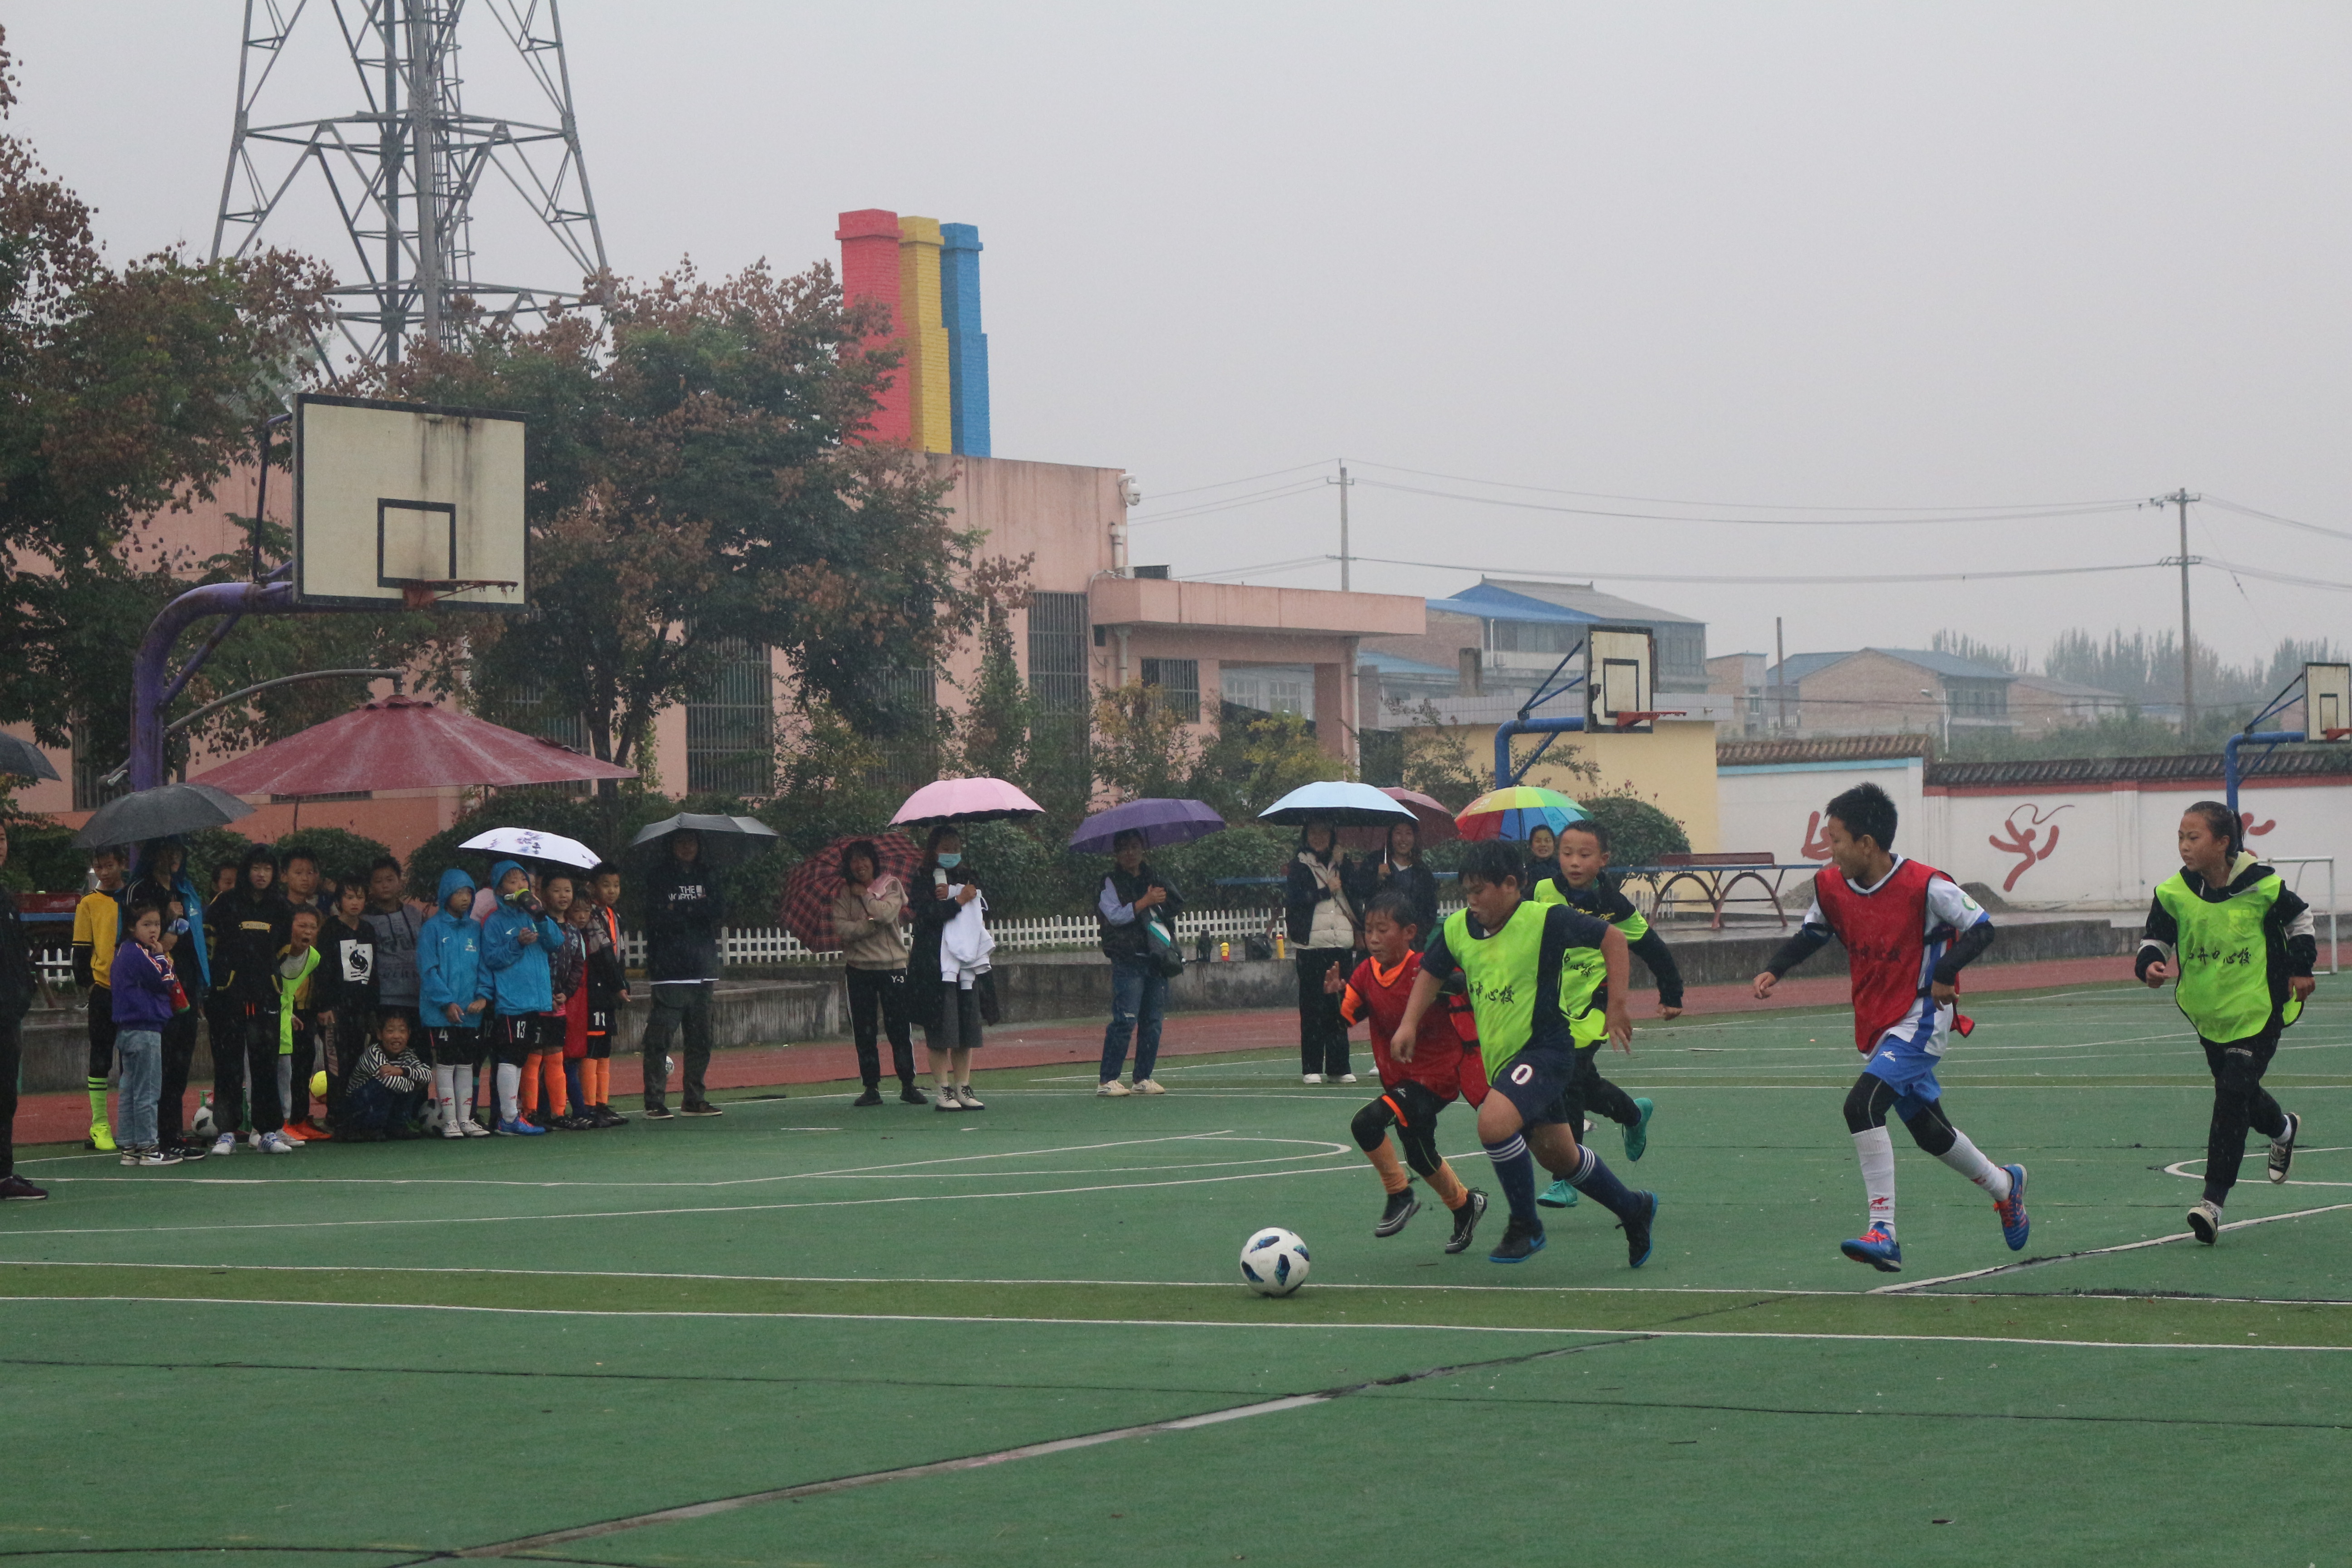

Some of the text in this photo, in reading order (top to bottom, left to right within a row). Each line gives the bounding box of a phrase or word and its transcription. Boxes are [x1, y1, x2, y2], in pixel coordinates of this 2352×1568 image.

[679, 885, 696, 894] THE
[593, 1011, 606, 1026] 11
[438, 1028, 449, 1041] 4
[516, 1021, 526, 1039] 13
[1510, 1064, 1533, 1085] 0
